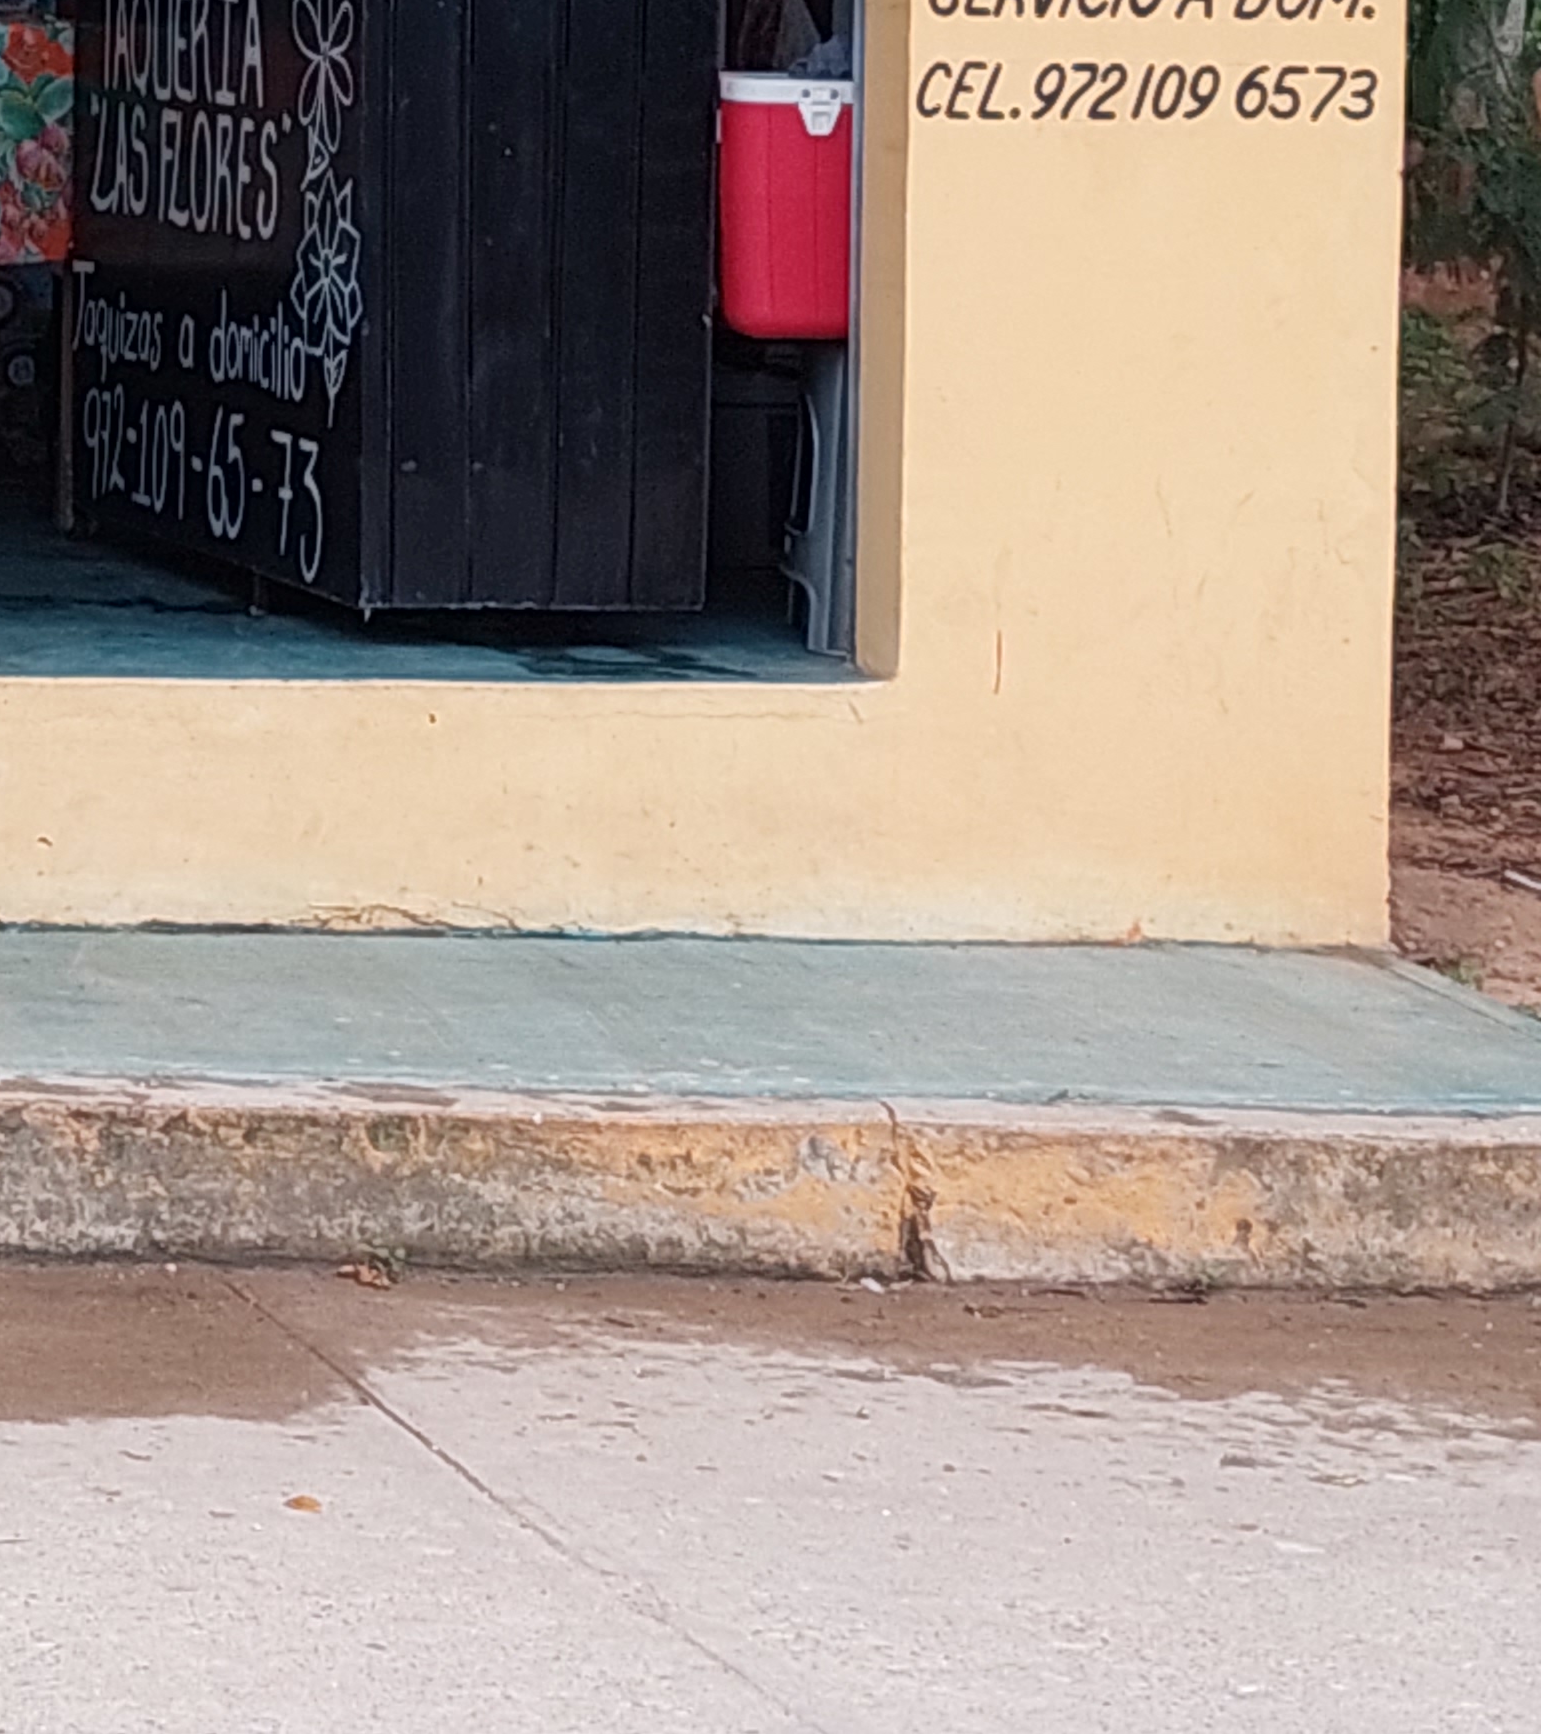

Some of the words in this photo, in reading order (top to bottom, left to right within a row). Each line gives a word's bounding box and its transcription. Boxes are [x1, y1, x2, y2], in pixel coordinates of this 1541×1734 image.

[1234, 63, 1378, 123] 6573
[71, 259, 164, 384] Taquizas
[177, 314, 195, 369] a
[209, 286, 306, 402] domicilio
